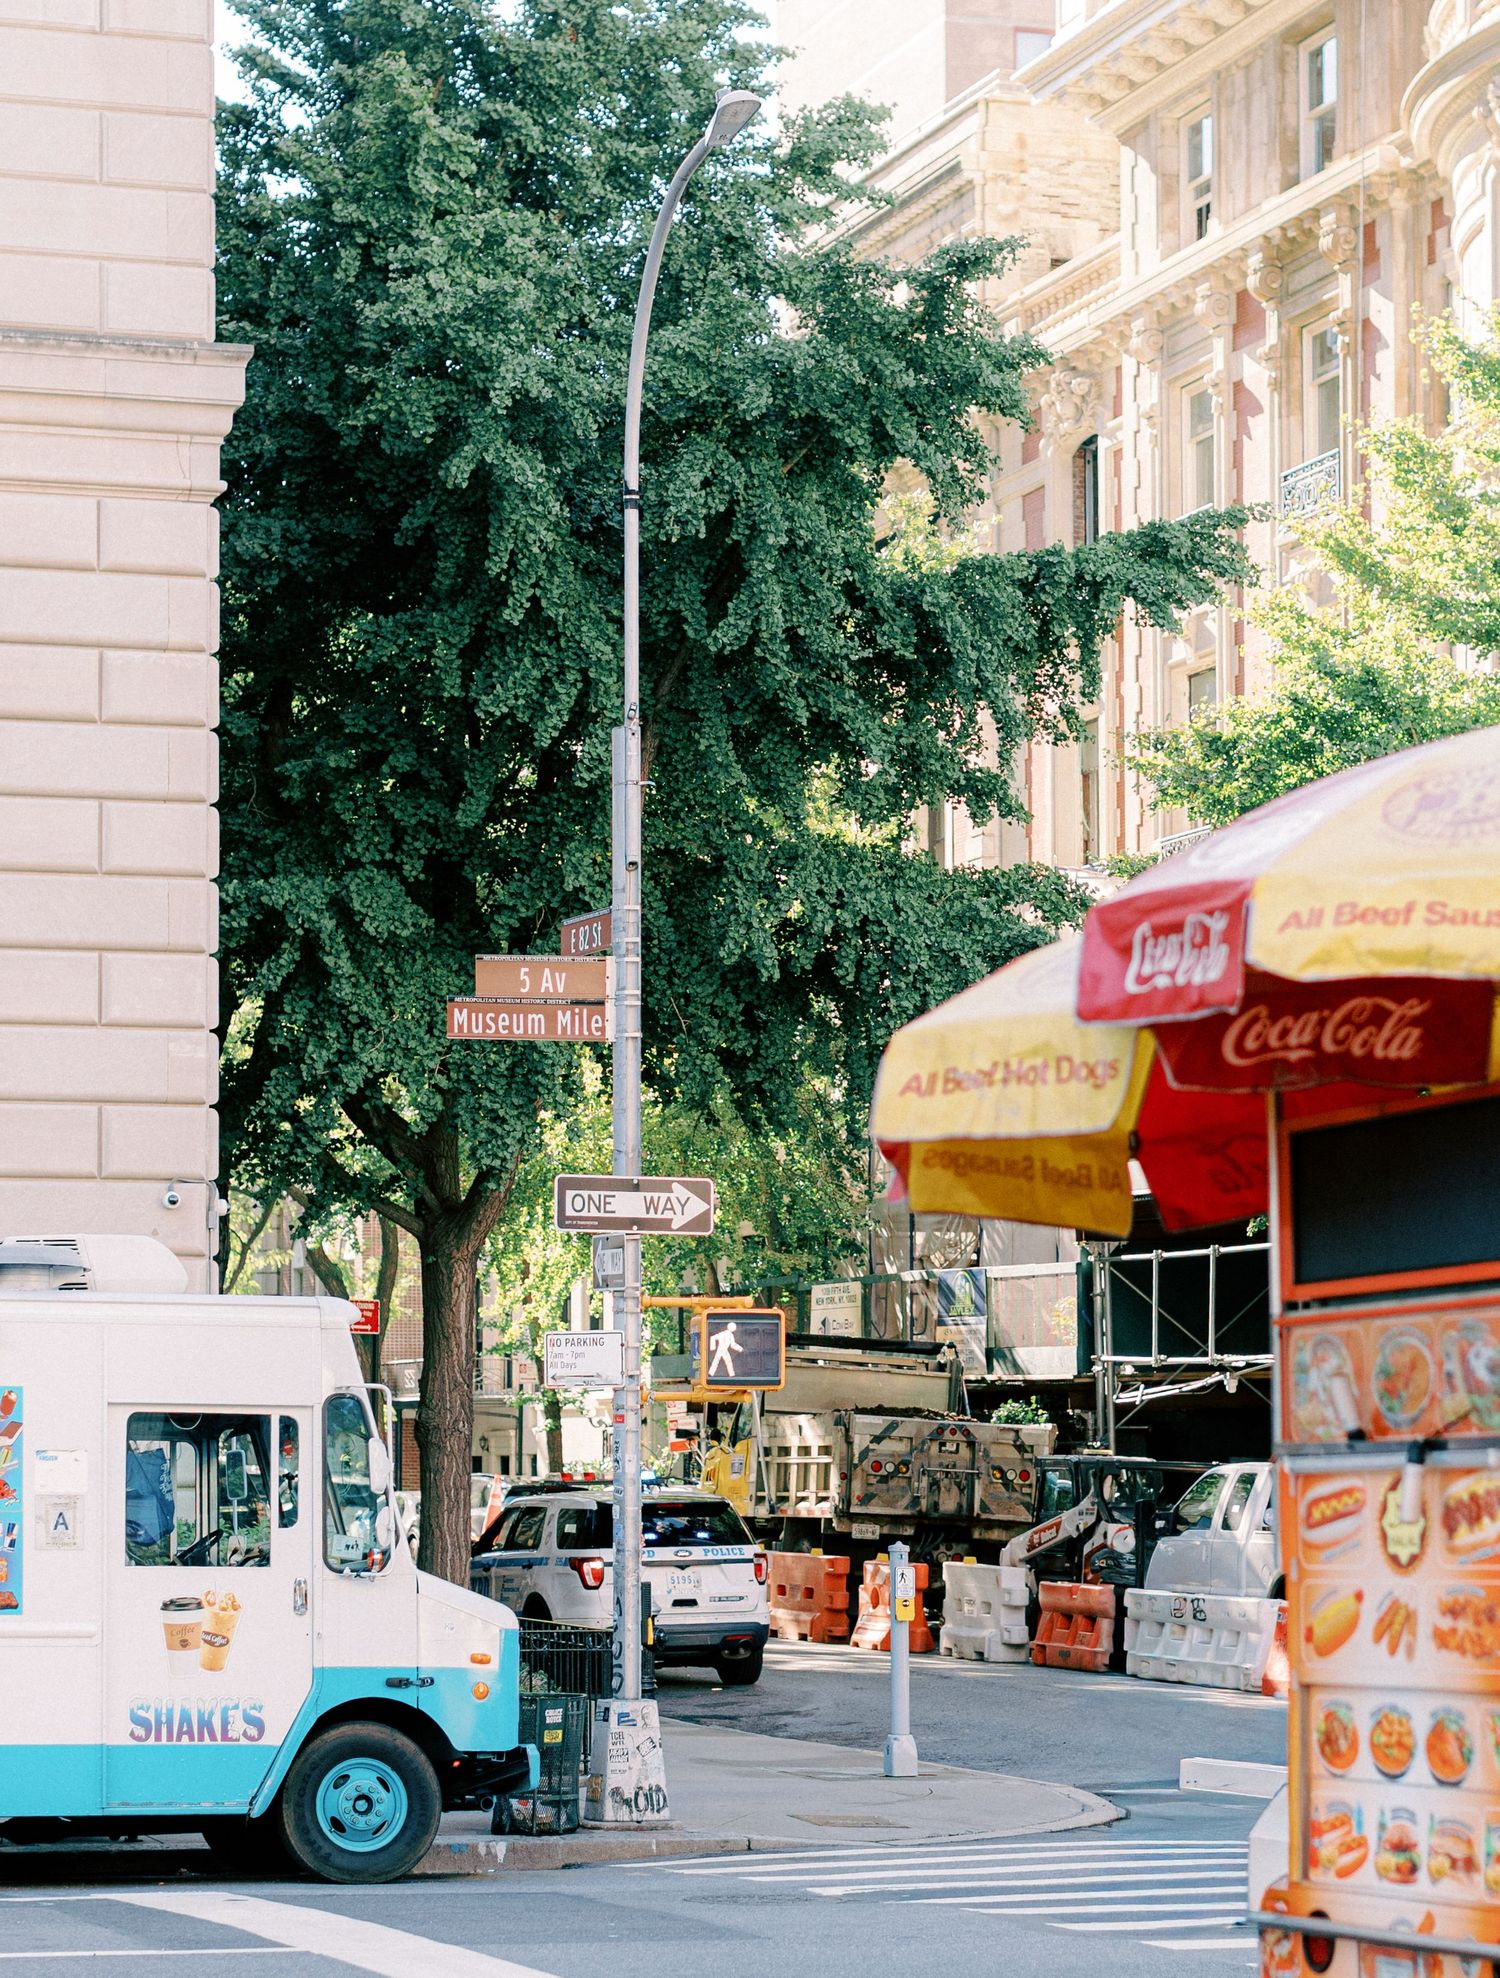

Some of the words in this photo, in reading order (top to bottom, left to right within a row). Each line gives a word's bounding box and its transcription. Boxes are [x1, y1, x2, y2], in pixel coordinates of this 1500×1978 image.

[1278, 906, 1325, 933] All
[1332, 901, 1416, 927] Beef
[571, 928, 576, 954] E
[579, 924, 590, 952] 82
[592, 921, 602, 948] St
[519, 967, 531, 994] 5
[540, 967, 567, 994] Av
[453, 1007, 546, 1036] Museum
[556, 1007, 603, 1036] Mile
[899, 1071, 938, 1098] All
[942, 1060, 998, 1096] Beef
[1002, 1057, 1051, 1088] Hot
[1055, 1054, 1120, 1090] Dogs
[571, 1193, 616, 1214] ONE
[643, 1195, 691, 1216] WAY
[815, 1297, 825, 1305] NEW
[549, 1338, 562, 1348] NO
[565, 1337, 605, 1347] PARKING
[549, 1351, 564, 1359] 7am
[570, 1350, 586, 1360] 7pm
[549, 1361, 558, 1369] All
[560, 1361, 577, 1370] Days
[52, 1511, 69, 1531] A
[702, 1547, 745, 1557] POLICE
[170, 1624, 196, 1638] Coffee
[128, 1696, 266, 1743] SHAKES
